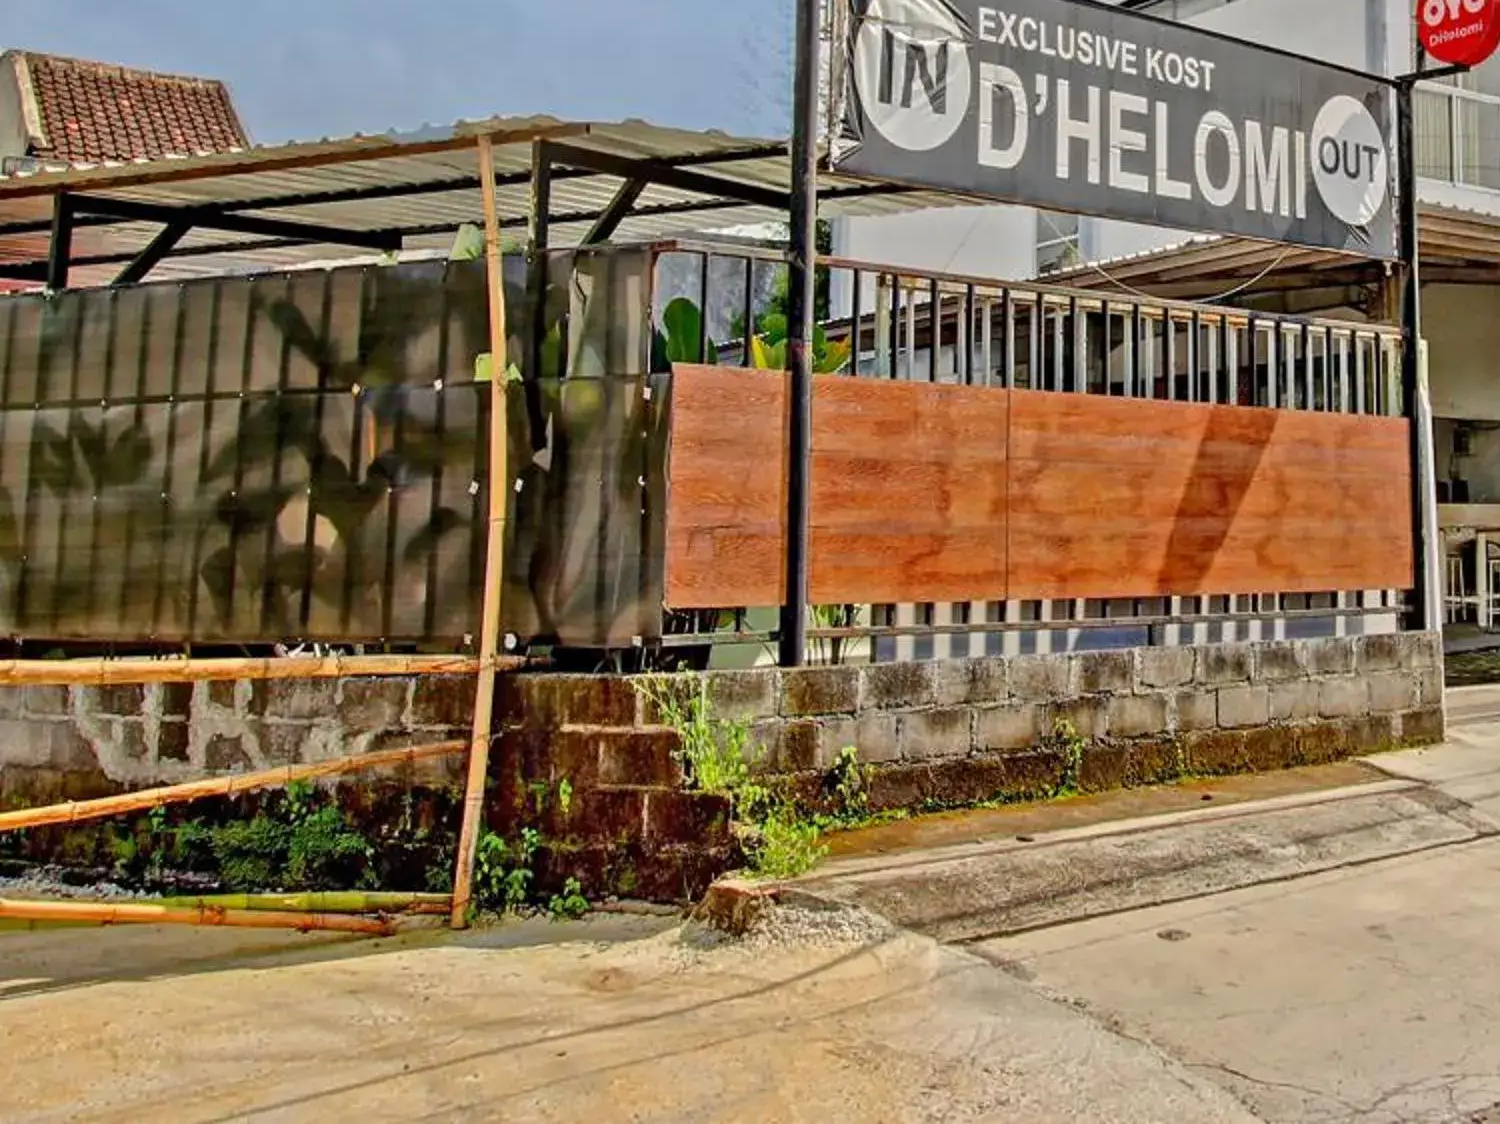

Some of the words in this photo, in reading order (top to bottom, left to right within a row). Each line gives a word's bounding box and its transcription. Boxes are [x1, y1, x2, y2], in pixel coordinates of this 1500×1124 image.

[878, 26, 946, 114] IN
[978, 7, 1137, 73] EXCLUSIVE
[1145, 49, 1215, 92] KOST
[978, 62, 1307, 220] D'HELOMI
[1318, 137, 1380, 183] OUT
